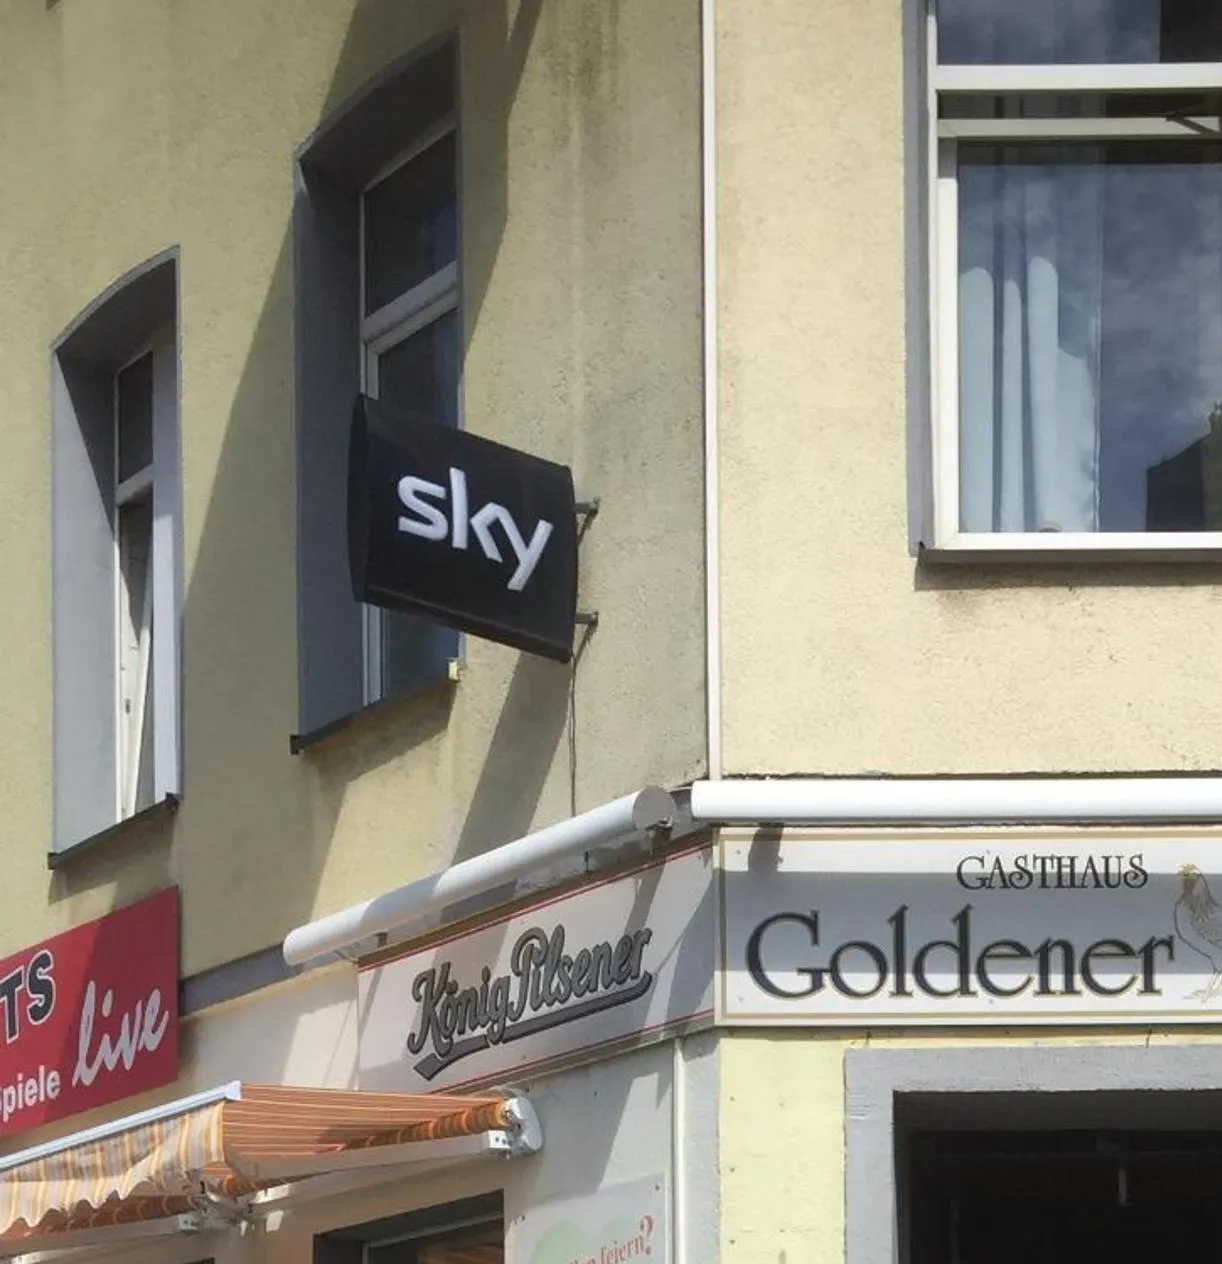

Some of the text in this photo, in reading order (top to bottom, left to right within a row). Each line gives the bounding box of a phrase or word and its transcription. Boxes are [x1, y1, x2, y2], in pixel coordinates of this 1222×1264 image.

[398, 466, 554, 591] sky
[957, 854, 1149, 890] GASTHAUS
[407, 923, 653, 1058] König Pilsener
[745, 902, 1175, 1000] Goldener
[72, 980, 169, 1087] live
[0, 1065, 60, 1123] piele
